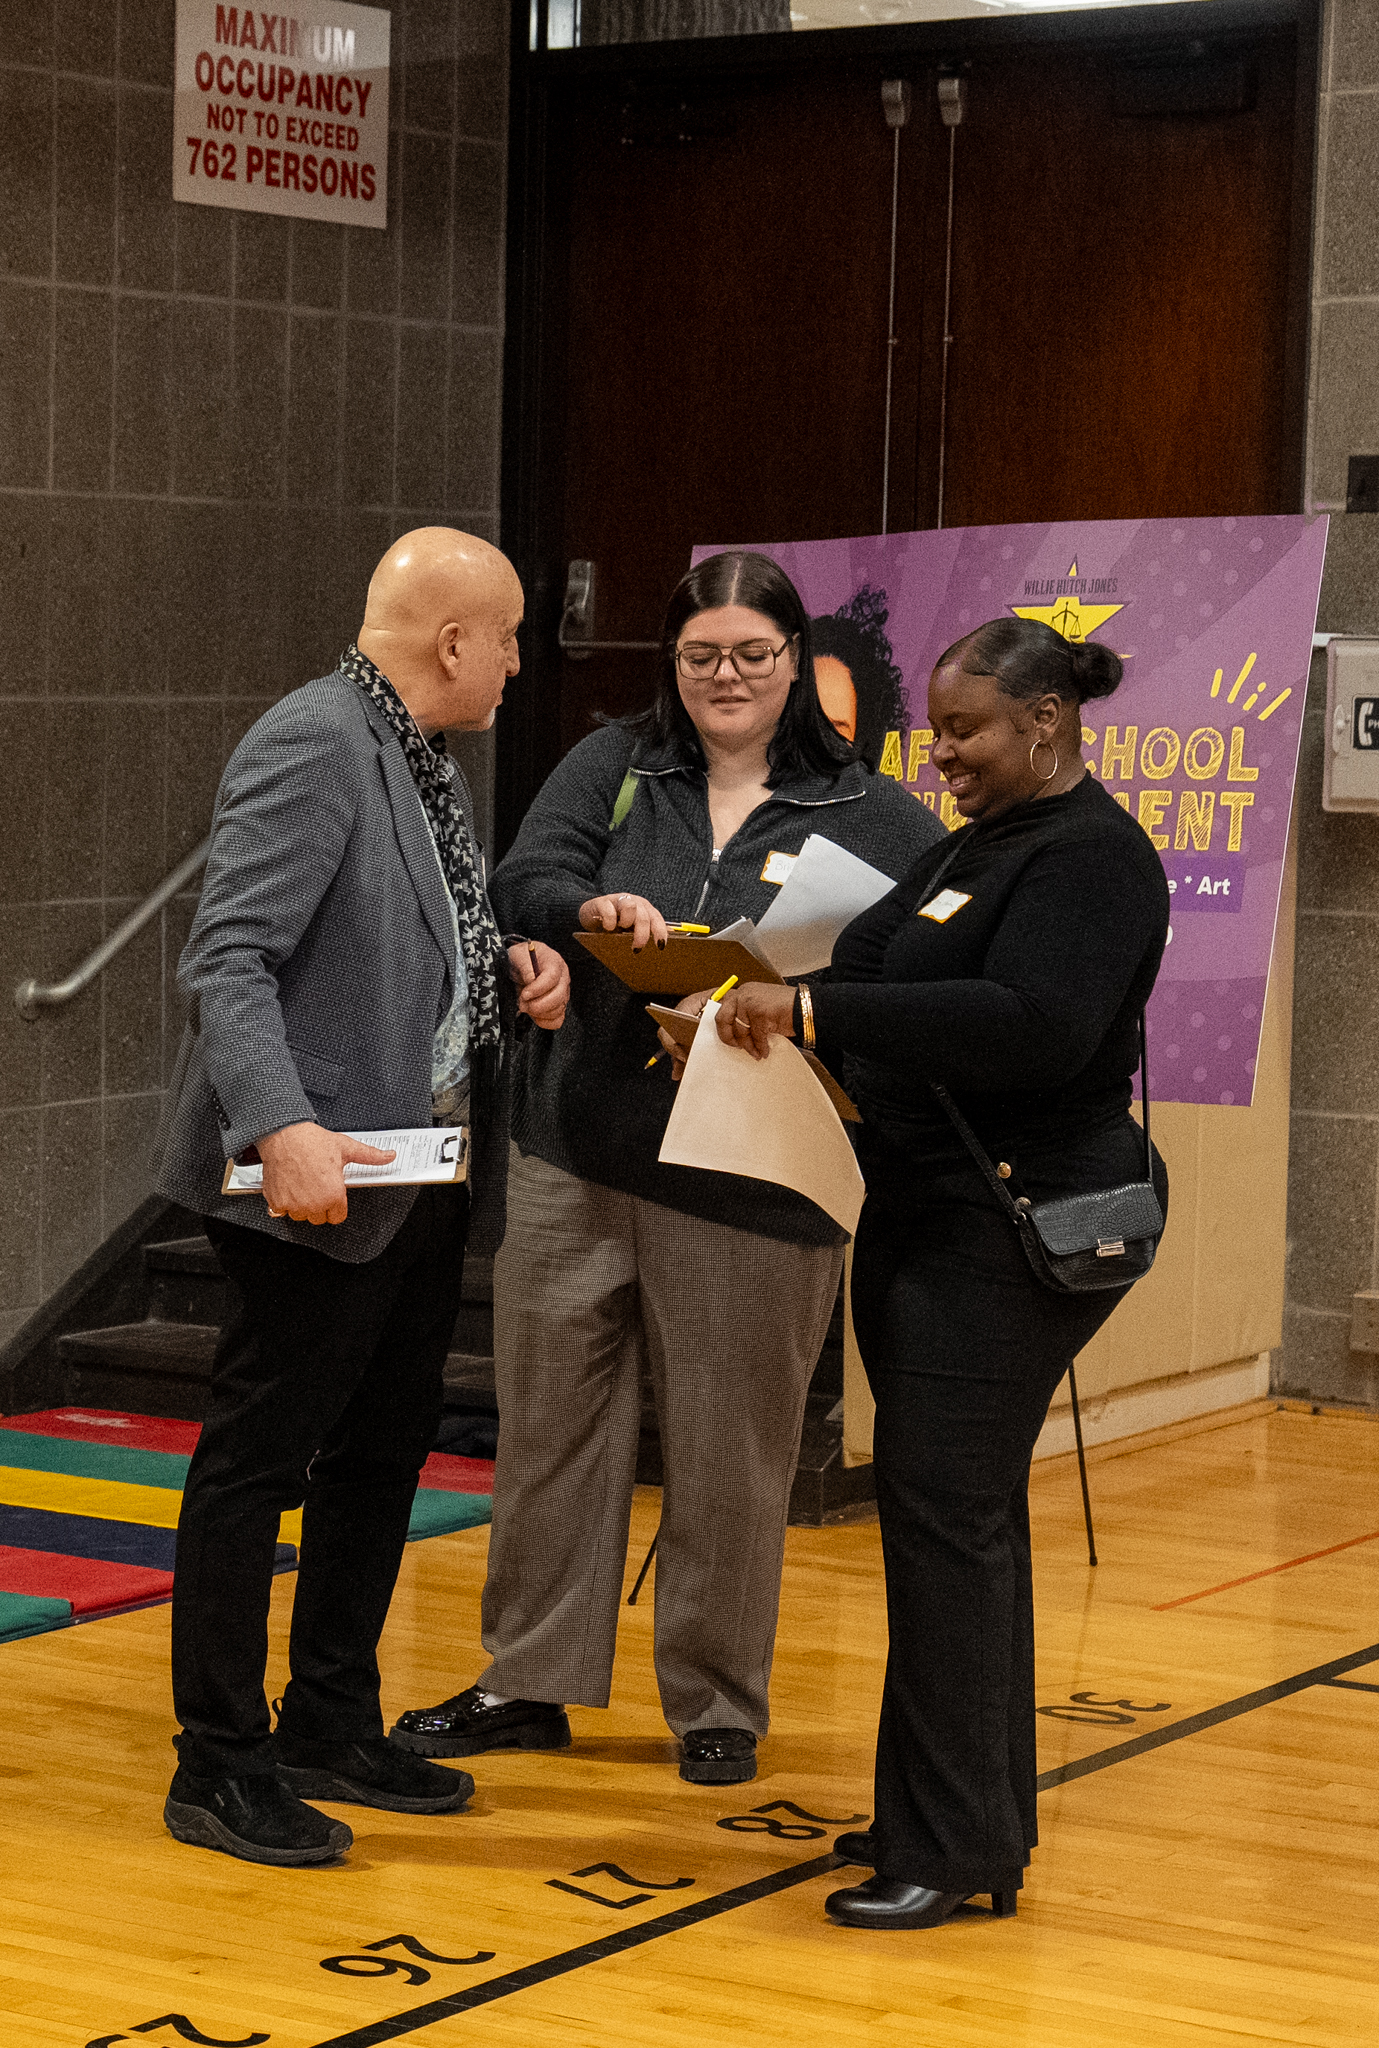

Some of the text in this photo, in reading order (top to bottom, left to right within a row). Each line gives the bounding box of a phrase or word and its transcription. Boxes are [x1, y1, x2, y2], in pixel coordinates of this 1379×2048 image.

[195, 51, 372, 118] OCCUPANCY
[207, 103, 359, 152] NOT TO EXCEED
[187, 137, 376, 201] 762 PERSONS
[1024, 577, 1118, 596] WILLIE HUTCH JONES
[1196, 876, 1231, 895] Art
[1036, 1692, 1172, 1724] 30
[716, 1800, 870, 1841] 28
[545, 1861, 697, 1910] 27
[320, 1934, 496, 1986] 26
